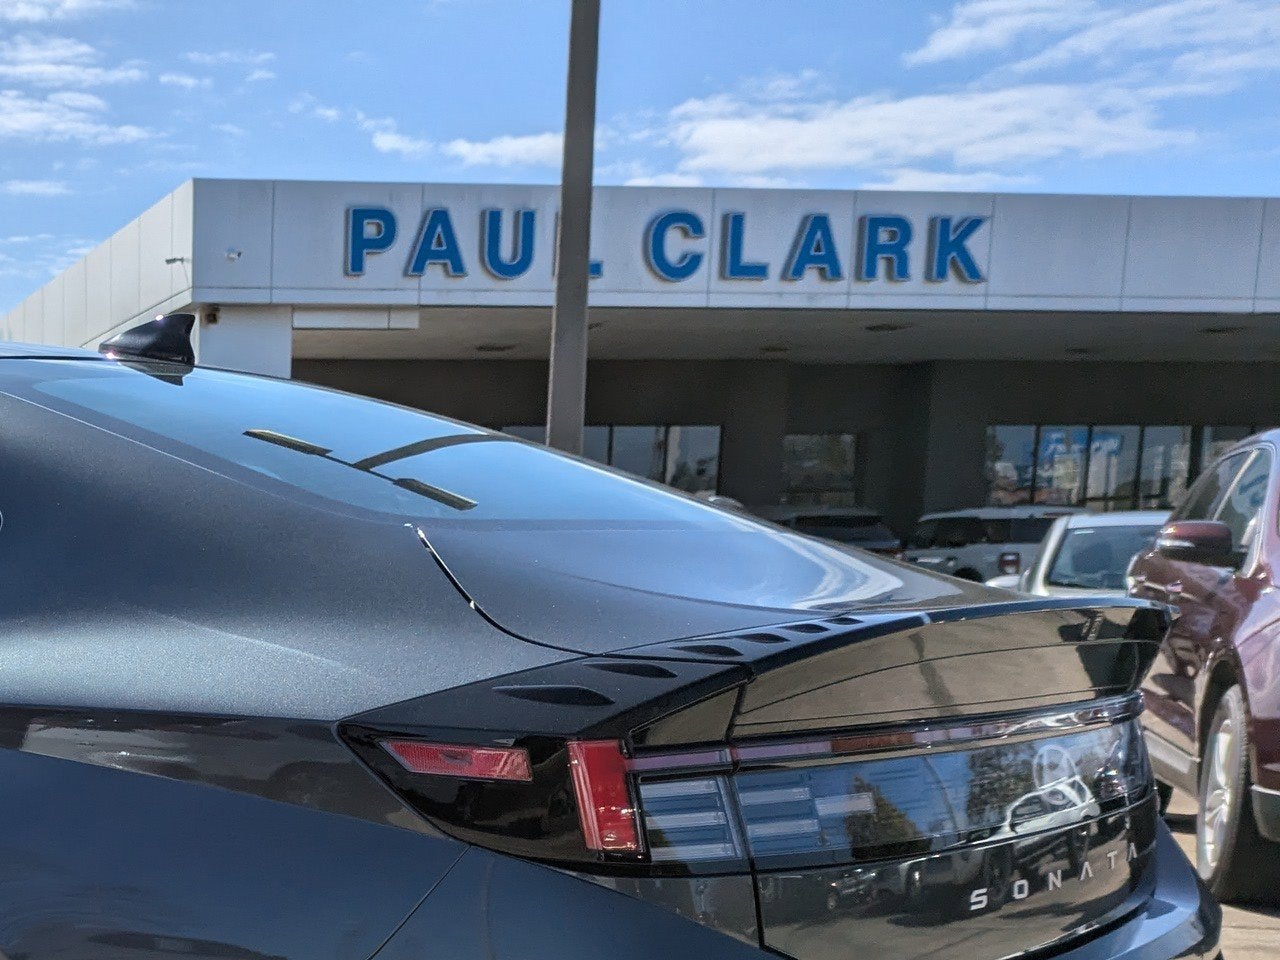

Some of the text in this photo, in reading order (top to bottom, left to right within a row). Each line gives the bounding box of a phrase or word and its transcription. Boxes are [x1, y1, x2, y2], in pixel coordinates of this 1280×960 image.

[344, 207, 989, 284] PAU CLARK
[969, 842, 1138, 911] SONATA
